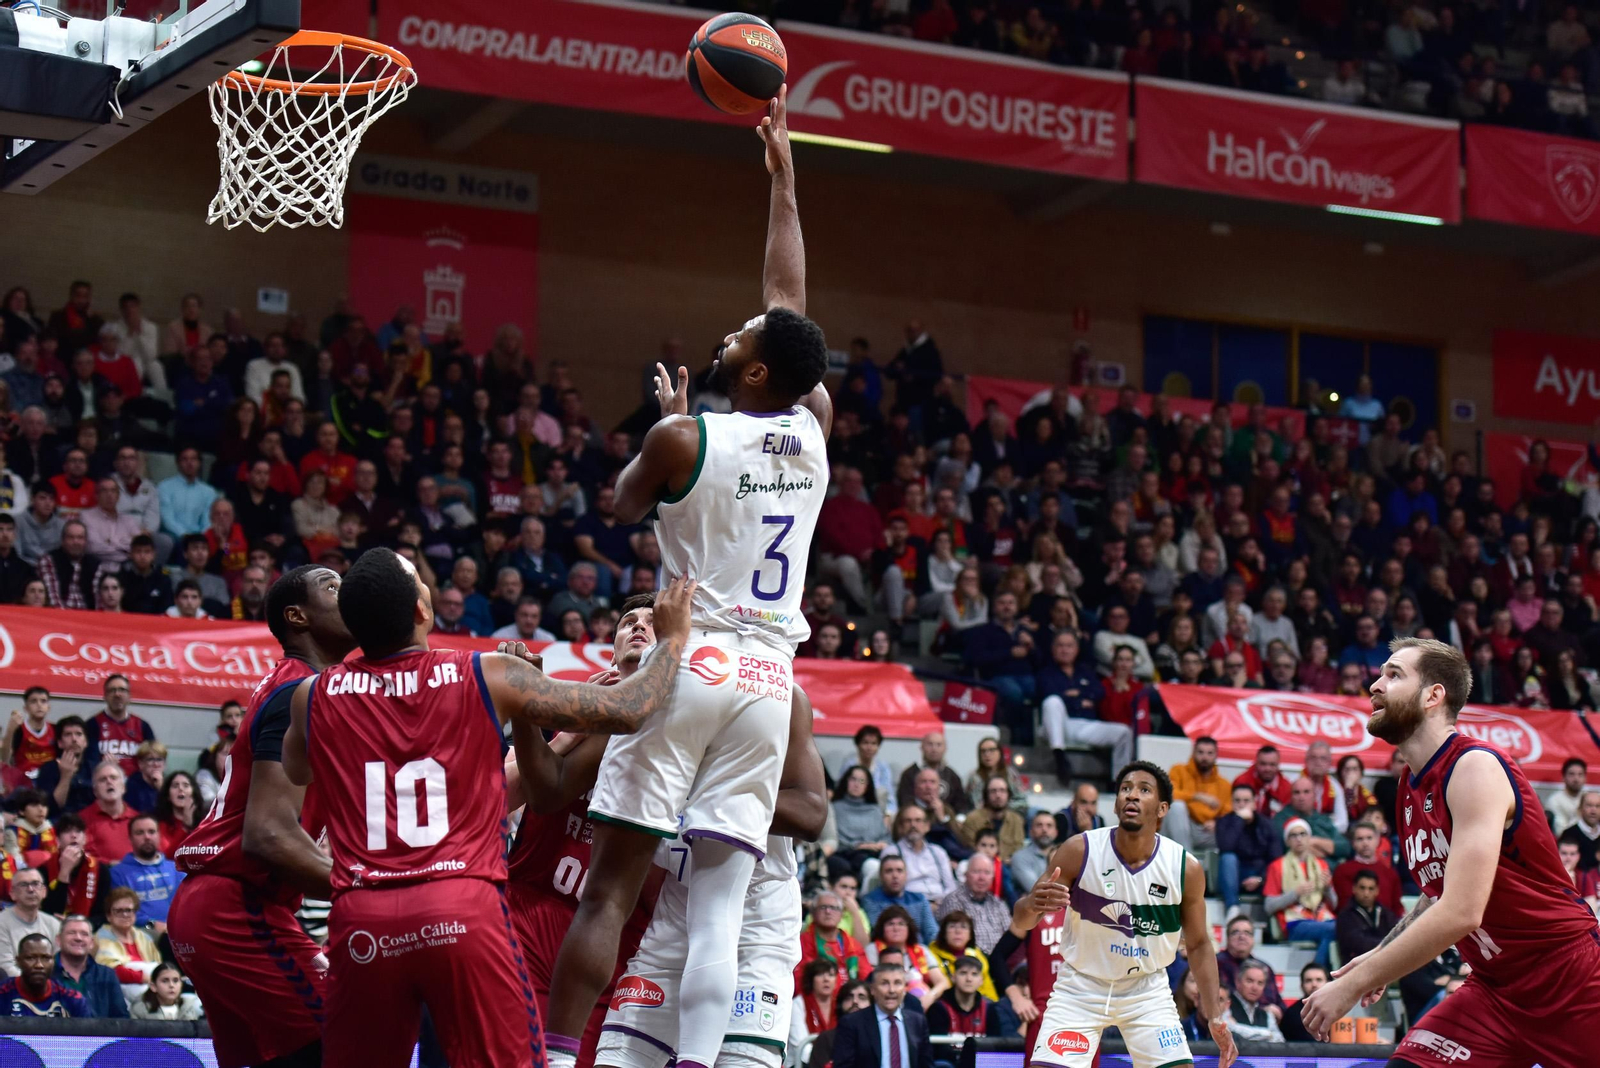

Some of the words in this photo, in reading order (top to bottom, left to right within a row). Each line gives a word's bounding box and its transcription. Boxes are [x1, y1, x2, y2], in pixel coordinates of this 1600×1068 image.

[844, 74, 1116, 147] GRUPOSURESTE
[361, 162, 447, 193] Grada
[458, 174, 529, 203] Norte
[762, 432, 801, 456] EJIM
[751, 515, 794, 601] 3
[39, 633, 176, 670] Costa
[184, 641, 276, 676] Cáli
[738, 656, 788, 677] COSTA
[326, 670, 418, 697] CAUPAIN
[427, 662, 463, 689] JR.
[735, 681, 789, 704] MÁLAGA
[738, 669, 764, 682] DEL
[767, 674, 789, 691] SOL
[365, 756, 450, 851] 10
[552, 855, 590, 902] 0
[1418, 862, 1447, 888] MUR
[378, 932, 418, 948] Costa
[420, 921, 467, 938] Cálida
[612, 980, 662, 1003] amadesa
